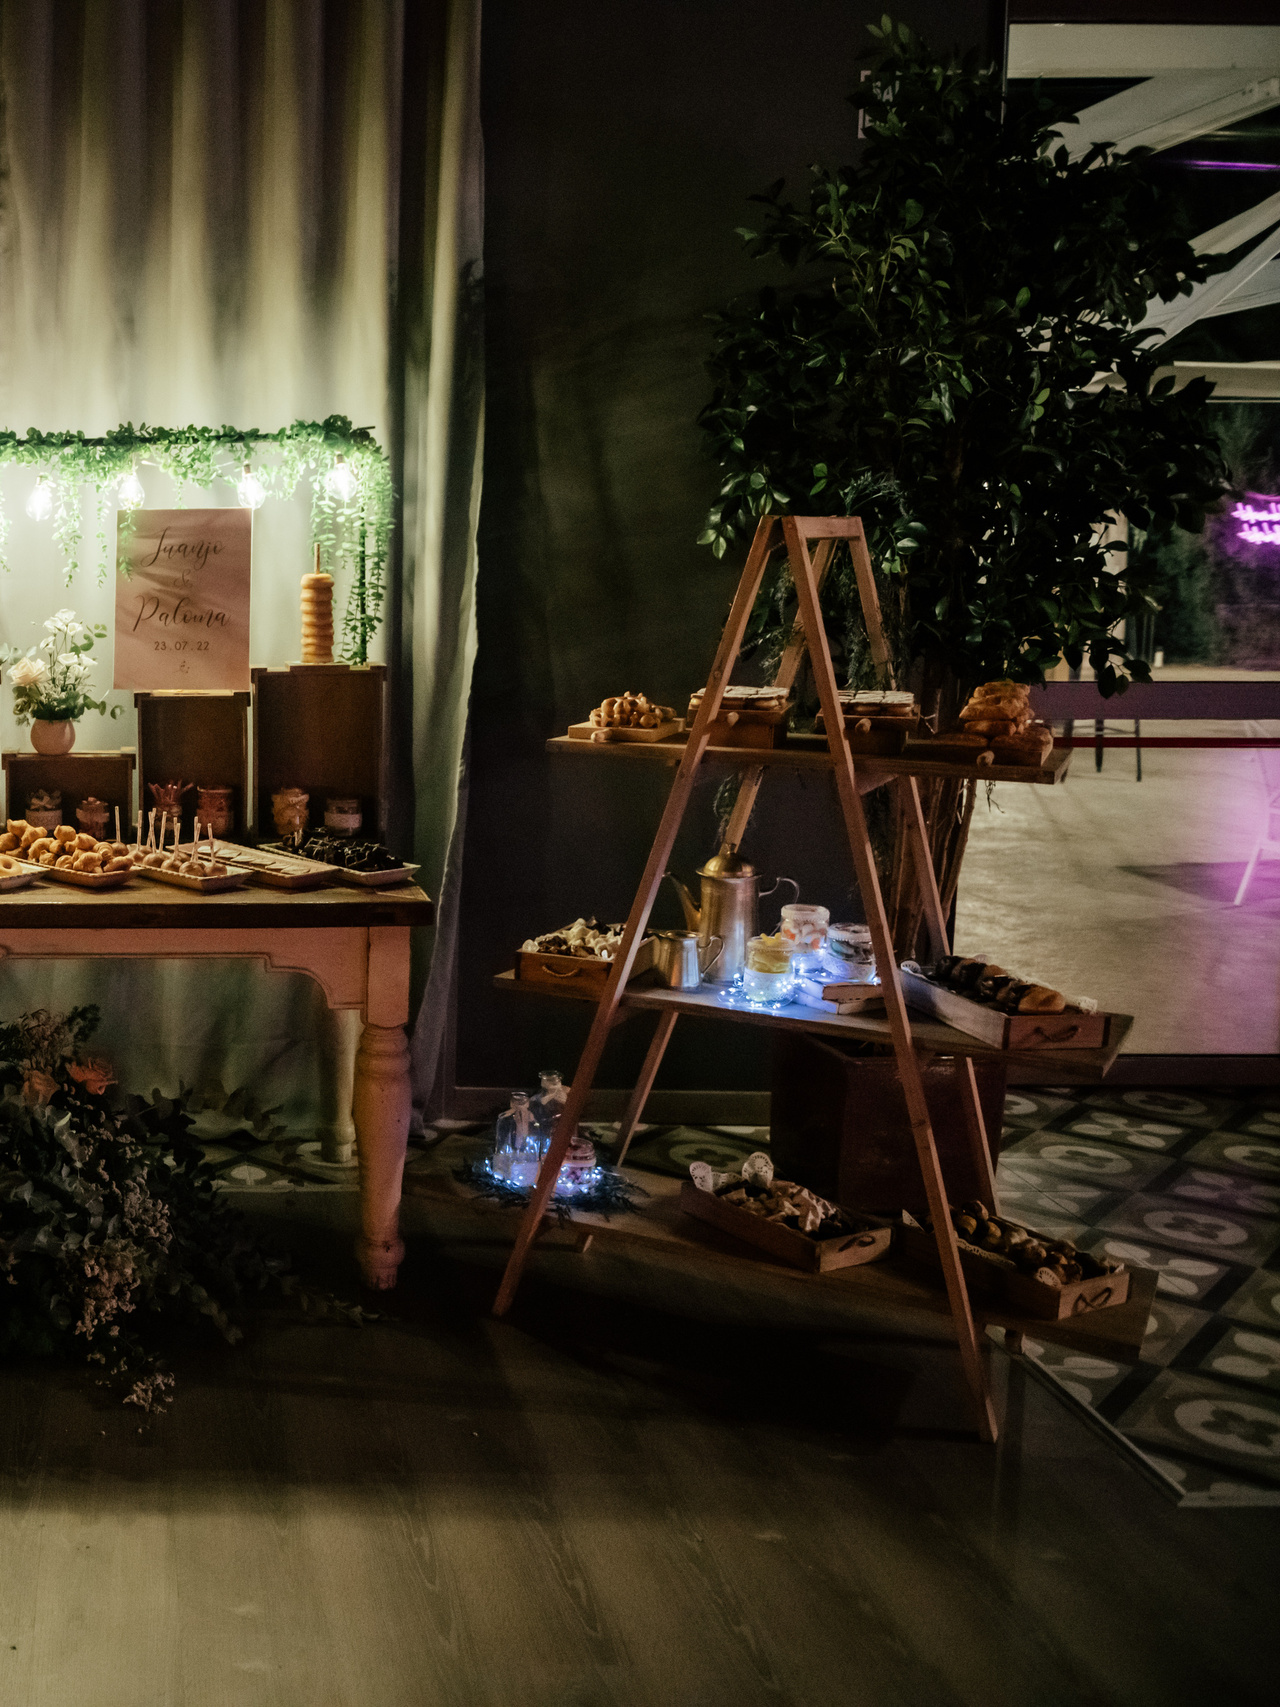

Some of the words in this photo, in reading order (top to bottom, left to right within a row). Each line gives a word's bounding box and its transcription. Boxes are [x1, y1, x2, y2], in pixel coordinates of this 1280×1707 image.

[141, 526, 226, 570] Juanjo
[173, 569, 194, 588] &
[132, 595, 231, 632] Paloma
